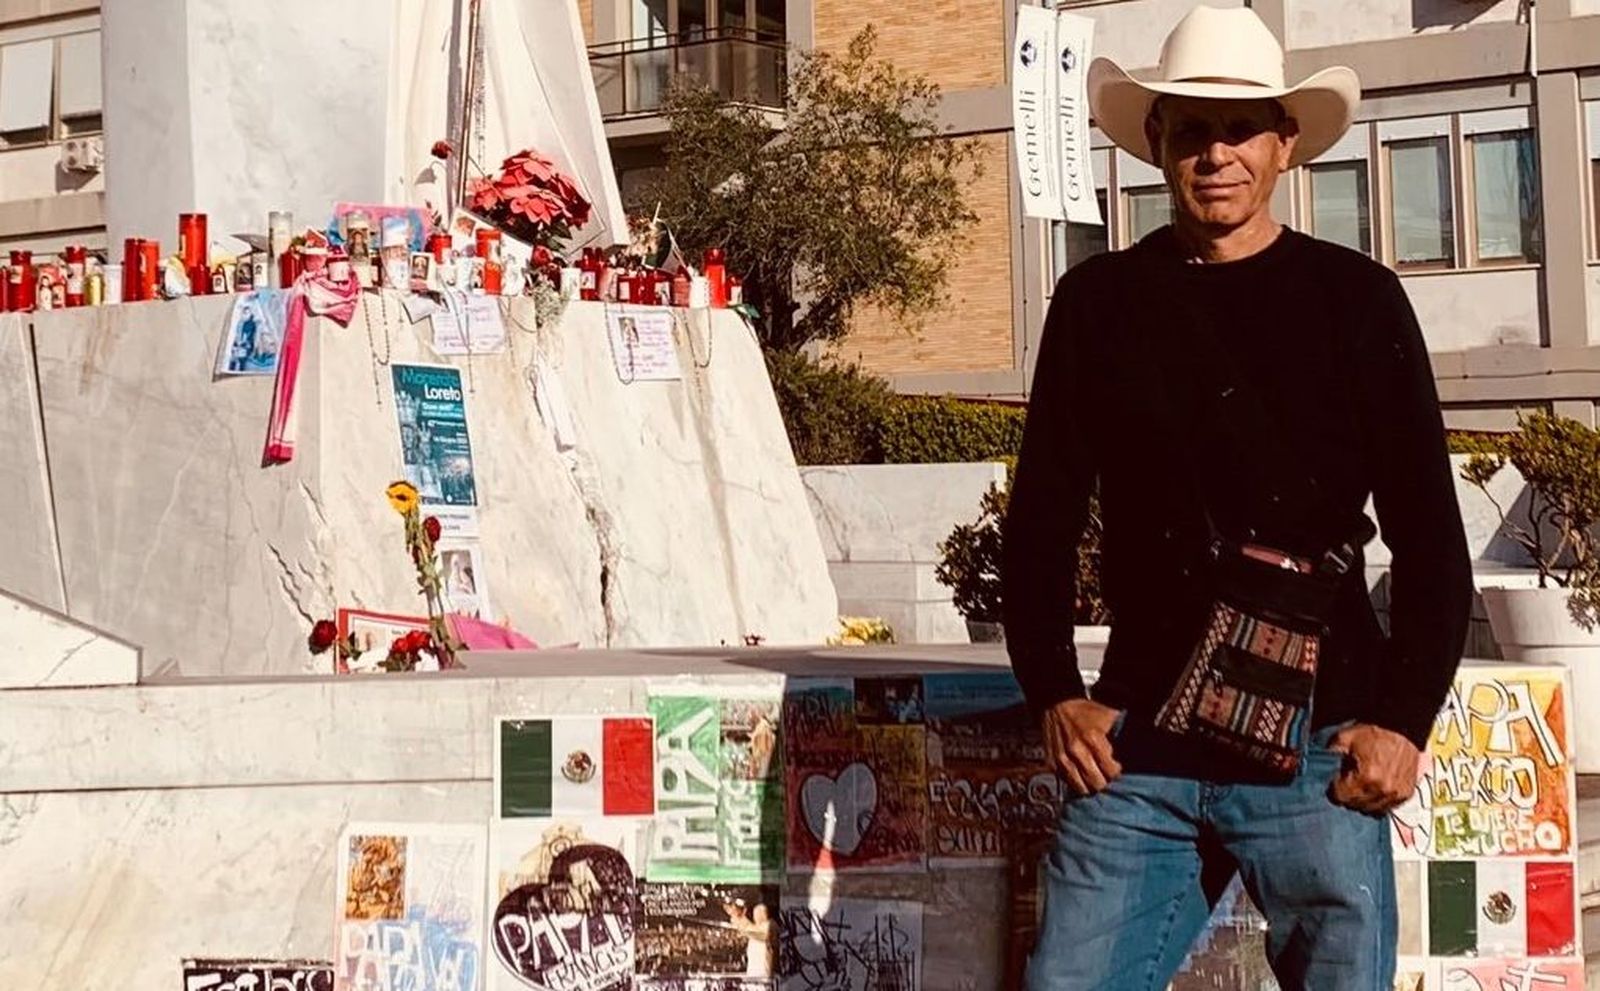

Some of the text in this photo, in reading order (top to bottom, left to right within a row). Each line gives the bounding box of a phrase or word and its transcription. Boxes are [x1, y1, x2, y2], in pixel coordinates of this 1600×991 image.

[1019, 90, 1042, 198] Gemelli
[1060, 96, 1080, 202] Gemelli
[424, 383, 461, 401] Loreto
[1436, 679, 1565, 768] APA
